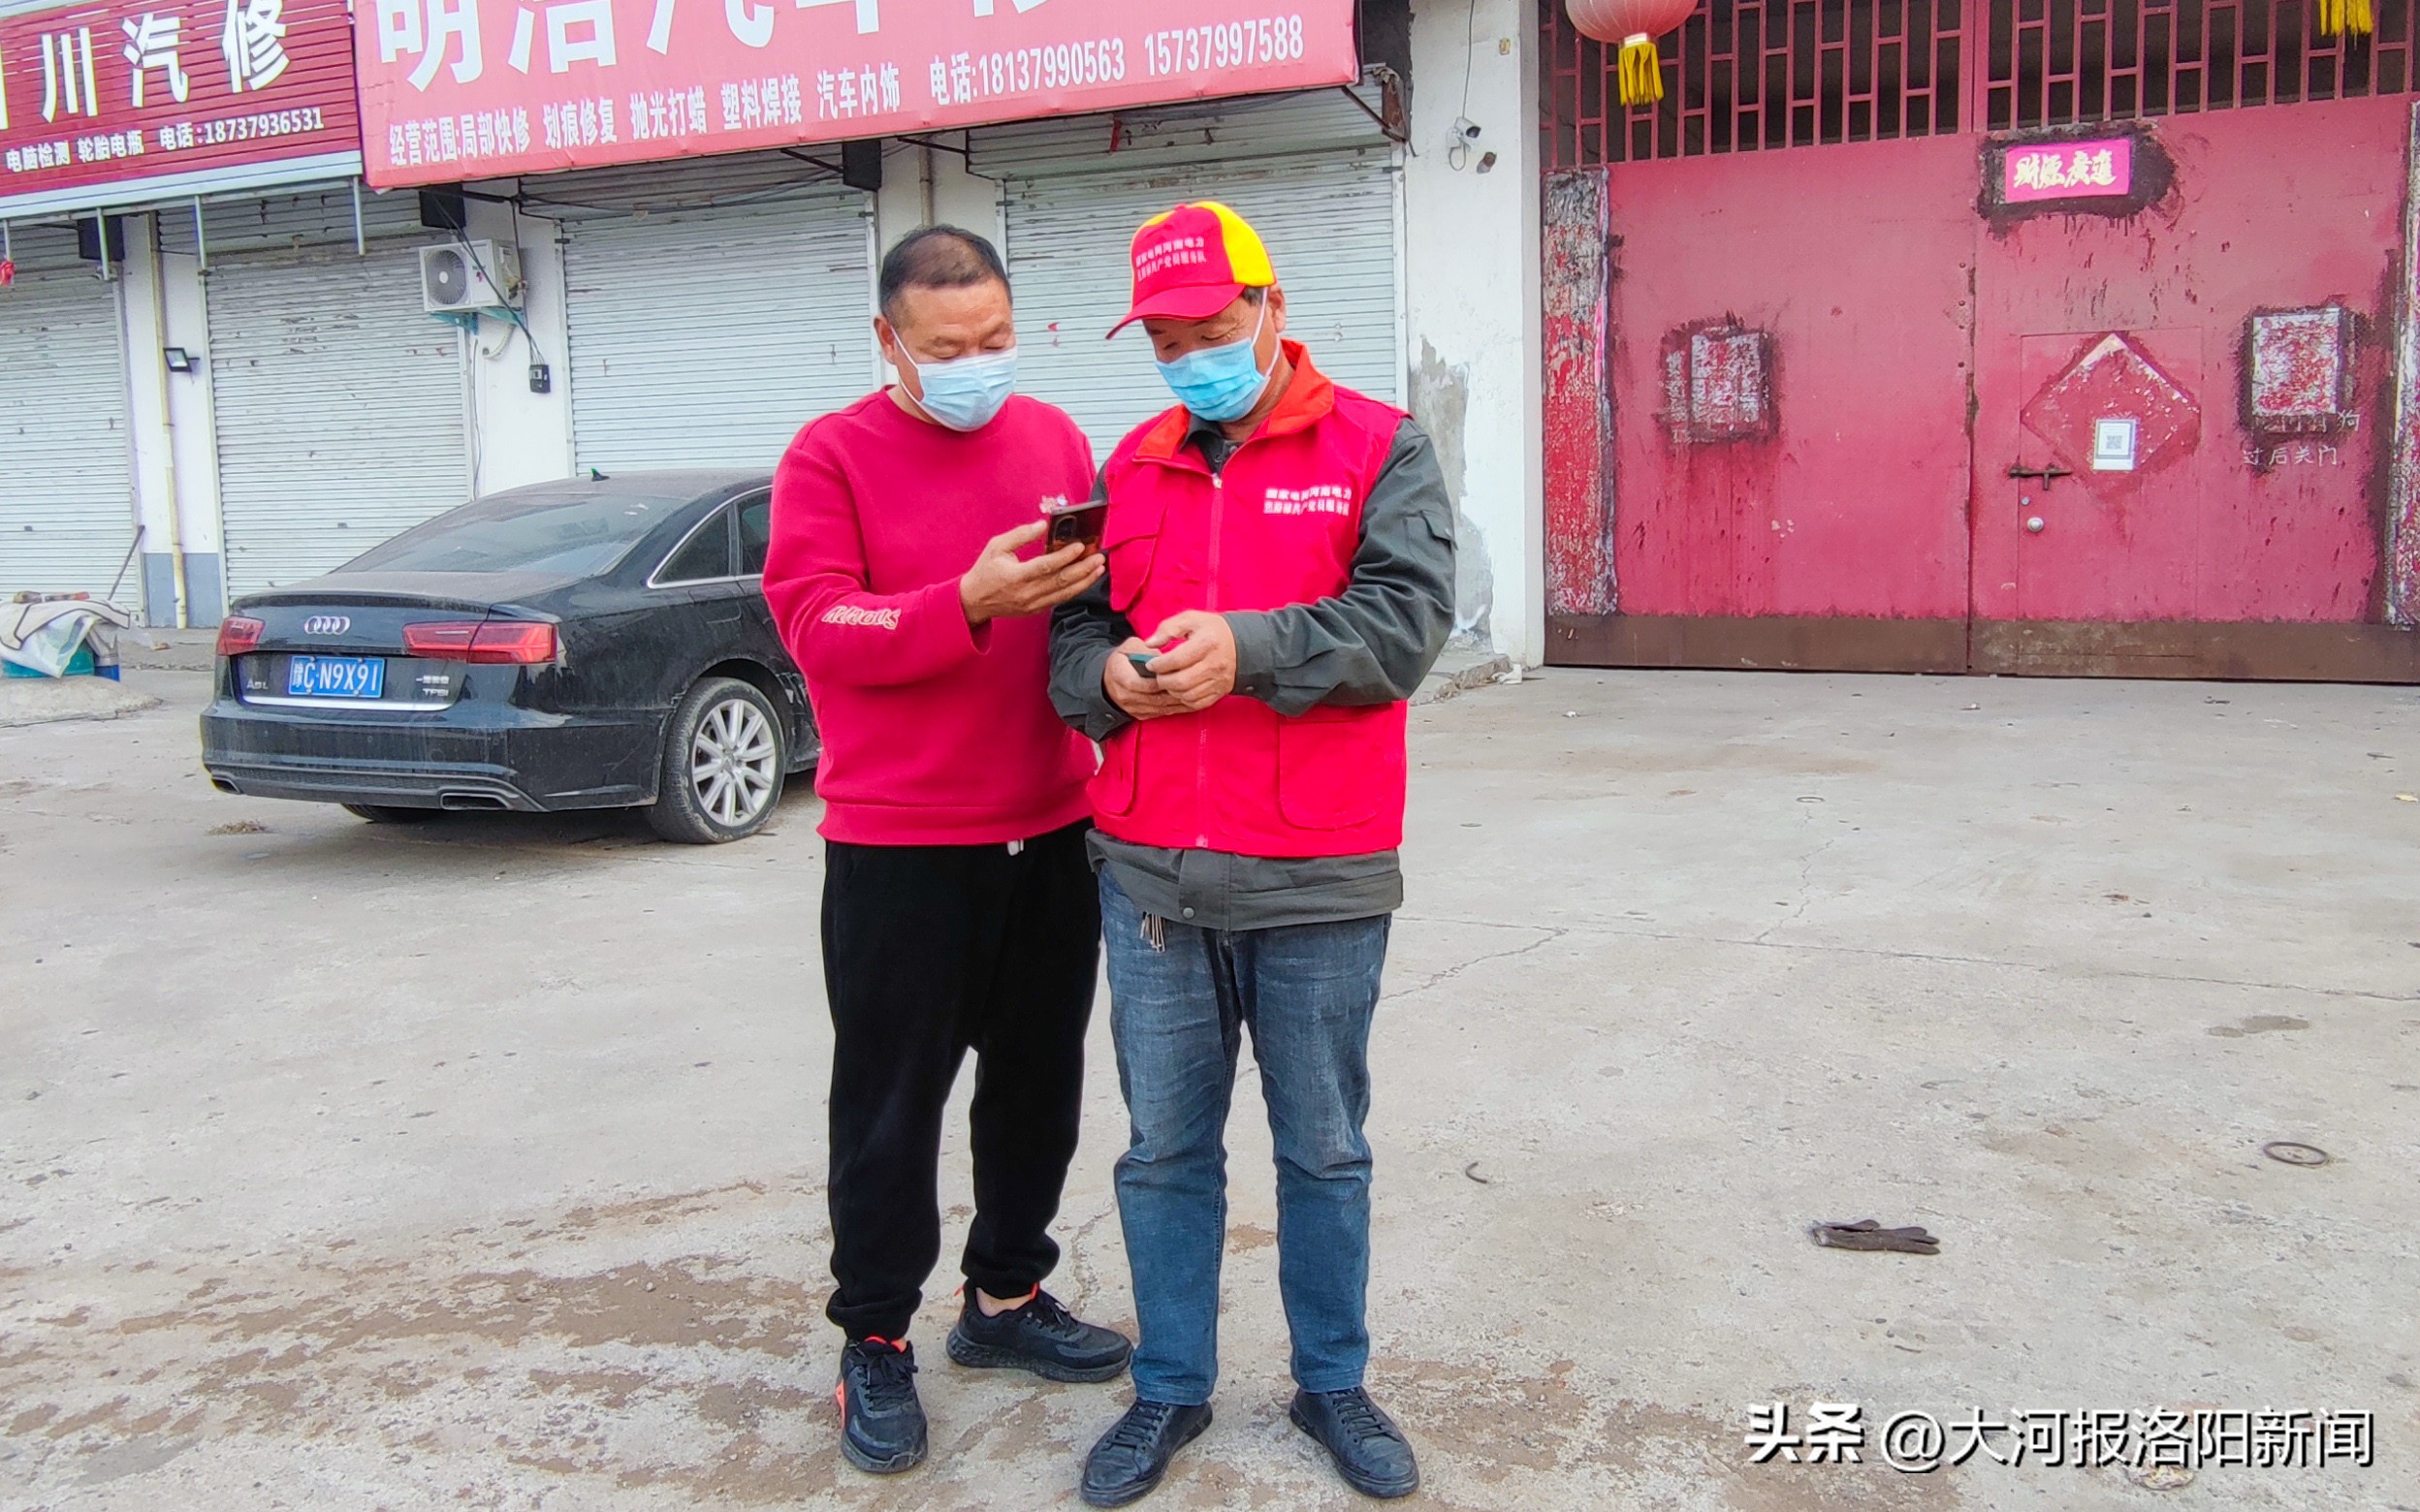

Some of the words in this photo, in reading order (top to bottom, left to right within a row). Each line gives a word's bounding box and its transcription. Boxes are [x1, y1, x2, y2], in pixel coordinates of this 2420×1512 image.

[0, 0, 290, 130] 川汽修
[390, 106, 530, 166] 经营范围:局部快修
[543, 97, 618, 149] 划痕修复
[630, 85, 708, 140] 抛光打蜡
[720, 74, 803, 130] 塑料焊接
[816, 62, 901, 119] 汽车内饰
[929, 38, 1126, 106] 电话:18137990563
[1144, 15, 1304, 77] 15737997588
[6, 140, 71, 173] 电脑检测
[77, 130, 144, 163] 轮胎电瓶
[159, 107, 325, 151] 电话:18737936531
